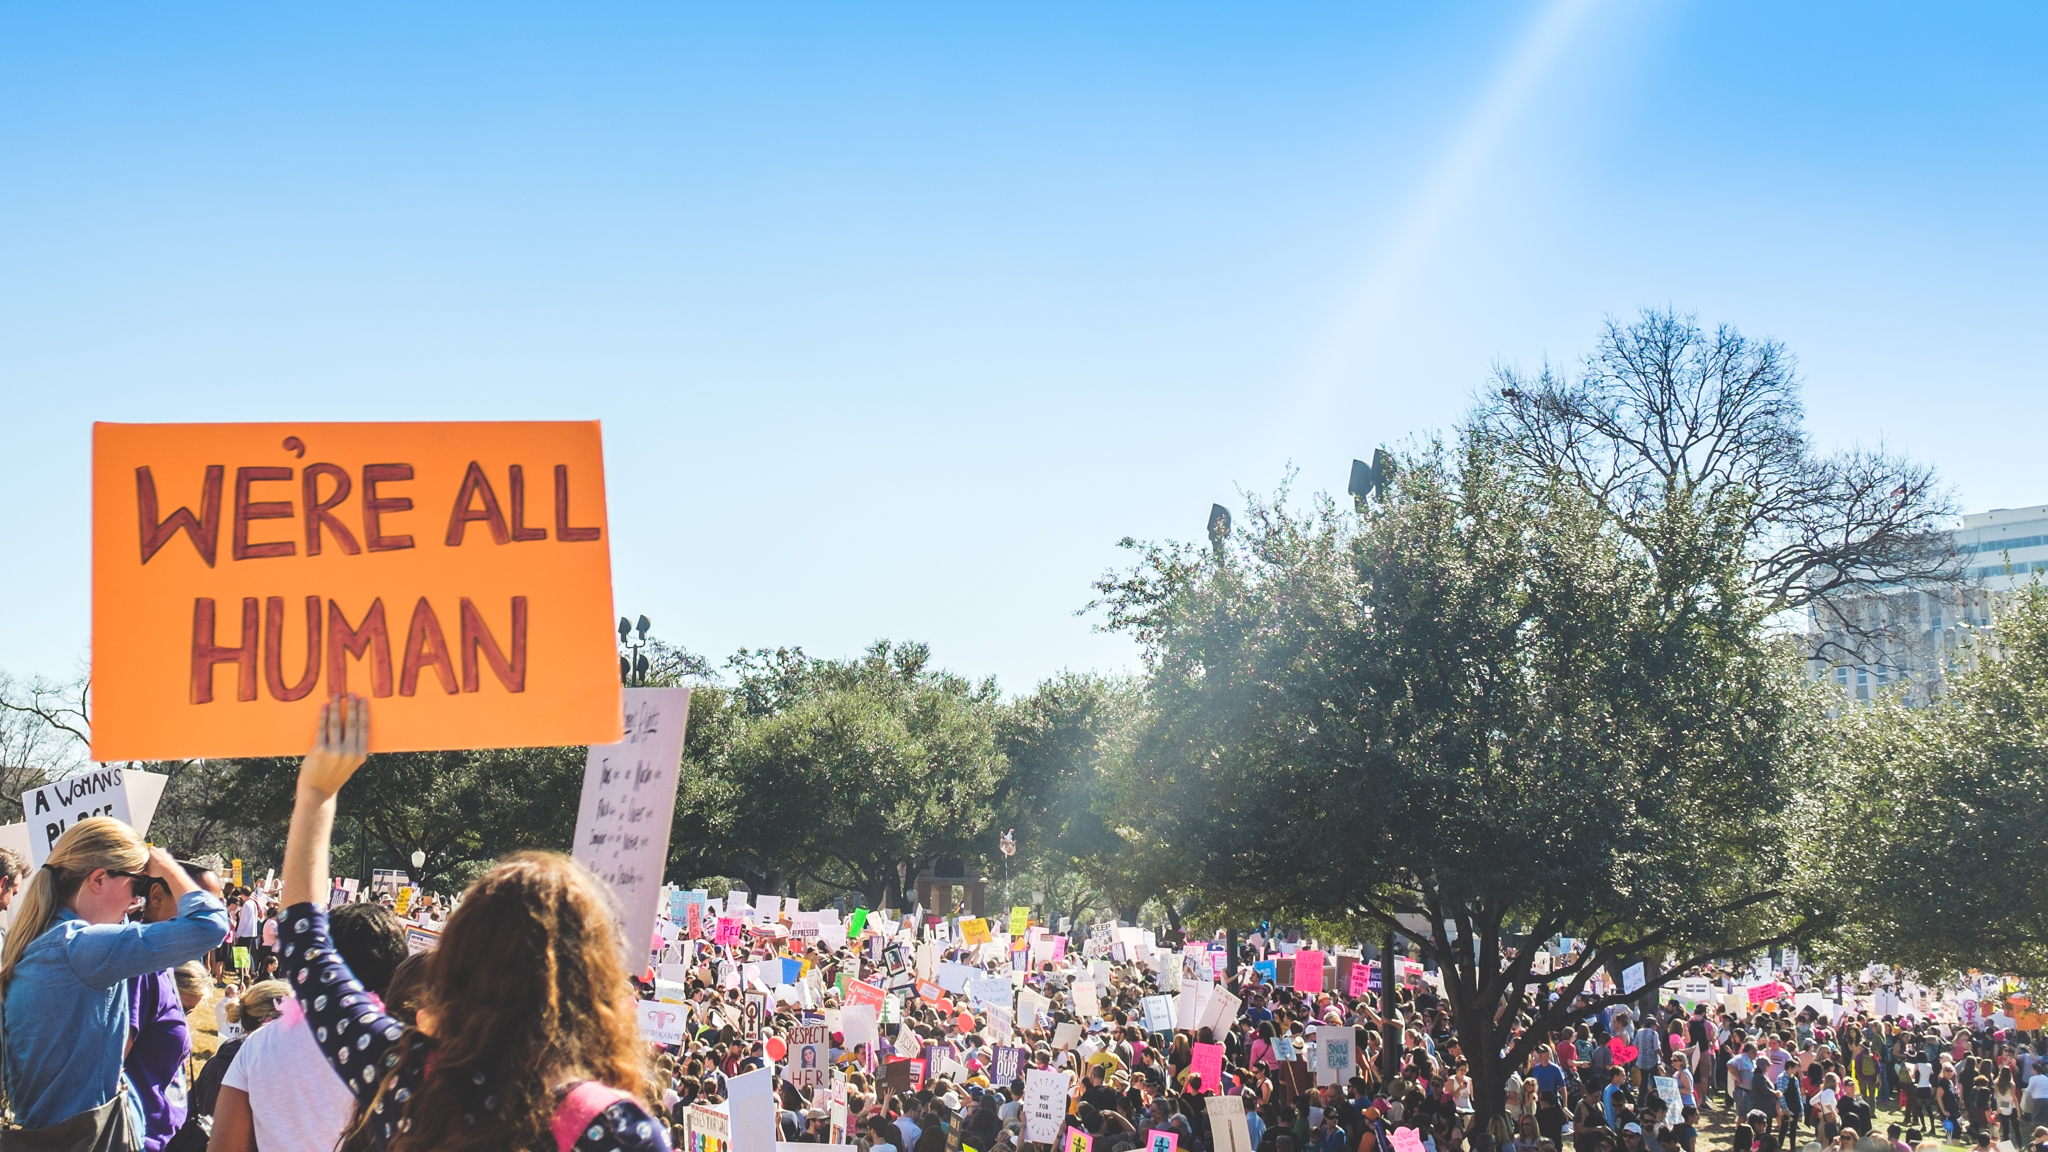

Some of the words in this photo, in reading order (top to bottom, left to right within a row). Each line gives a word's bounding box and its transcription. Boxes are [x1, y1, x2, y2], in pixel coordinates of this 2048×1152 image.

[135, 436, 416, 568] WE'RE
[445, 460, 602, 546] ALL
[189, 595, 528, 705] HUMAN
[35, 790, 50, 816] A
[54, 768, 122, 807] WOMAN'S
[1090, 923, 1111, 931] KEEP
[1091, 930, 1112, 938] HOPE
[1093, 944, 1113, 954] FIGH
[1301, 970, 1316, 980] OFF
[789, 1026, 828, 1045] RESPECT
[931, 1048, 950, 1060] HEAR
[998, 1048, 1019, 1062] HEAR
[930, 1058, 942, 1074] OU
[996, 1061, 1018, 1076] OUR
[792, 1070, 824, 1086] HER
[996, 1076, 1013, 1087] VOIC
[1035, 1112, 1052, 1120] GRABS
[706, 1115, 717, 1132] YOUR
